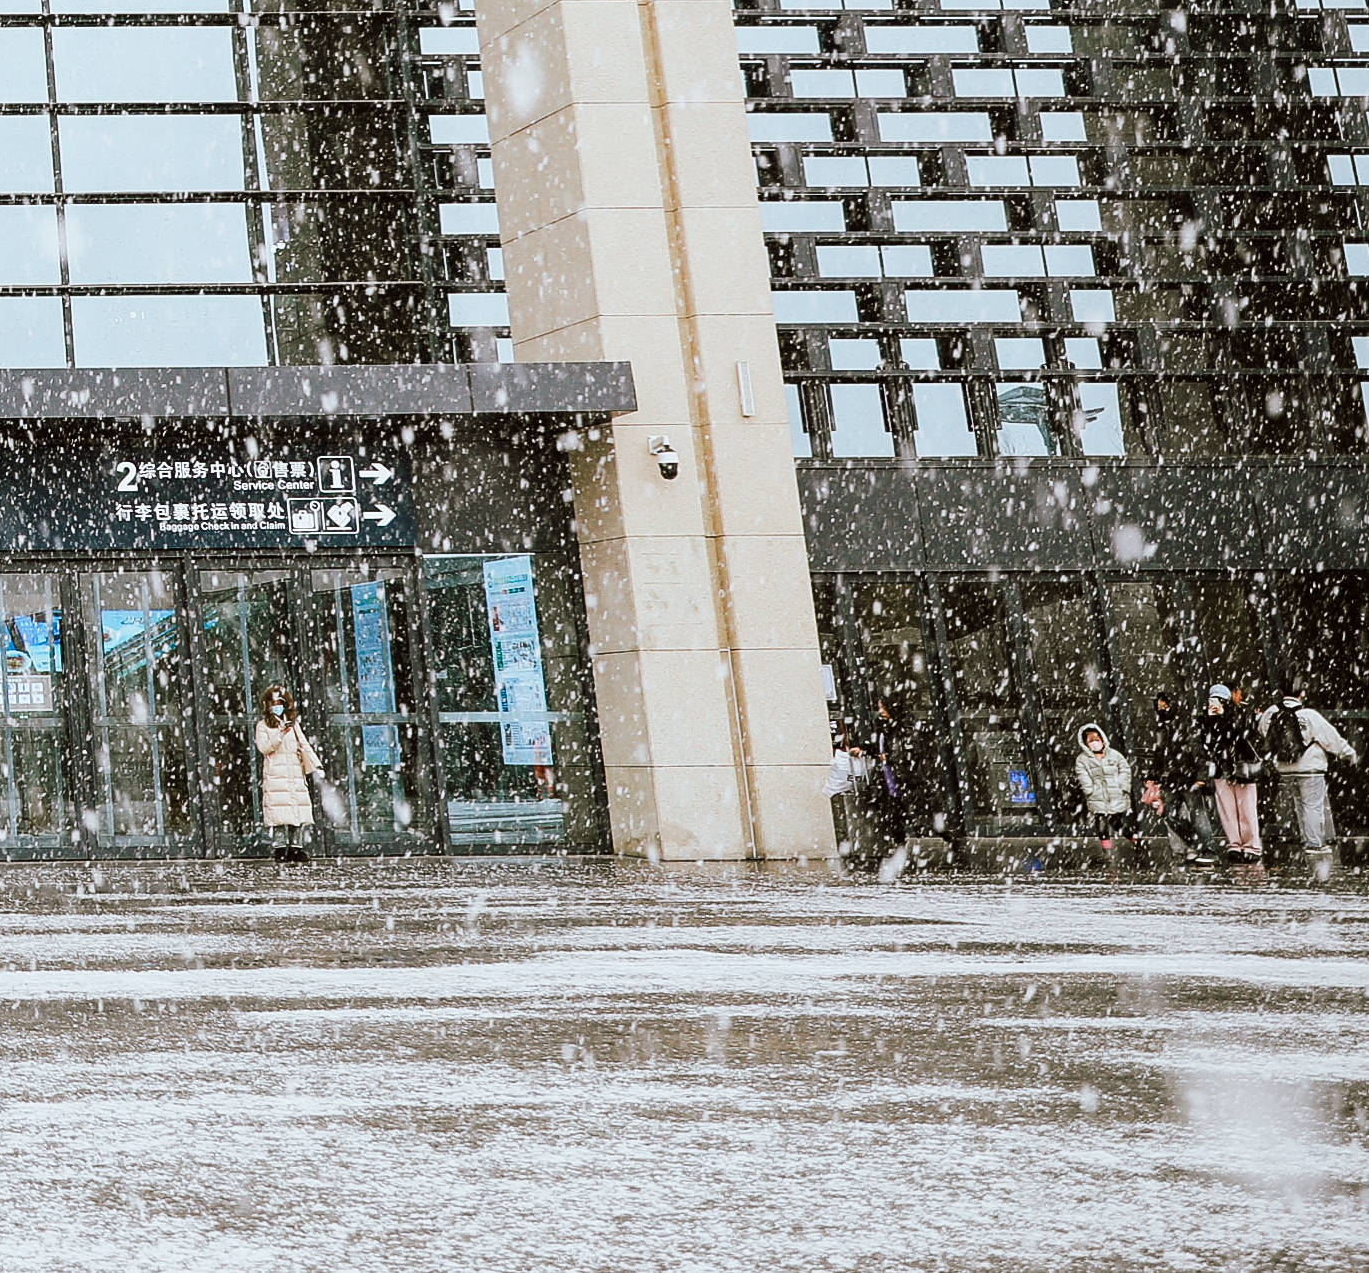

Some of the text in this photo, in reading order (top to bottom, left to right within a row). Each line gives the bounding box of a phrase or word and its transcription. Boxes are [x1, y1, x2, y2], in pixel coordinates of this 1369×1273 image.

[116, 461, 139, 492] 2
[233, 480, 315, 491] Service Center
[115, 501, 286, 522] 行李包裹托运领取处
[159, 522, 200, 533] Baggage
[200, 521, 230, 530] Check
[240, 521, 258, 530] and
[259, 521, 286, 530] Claim
